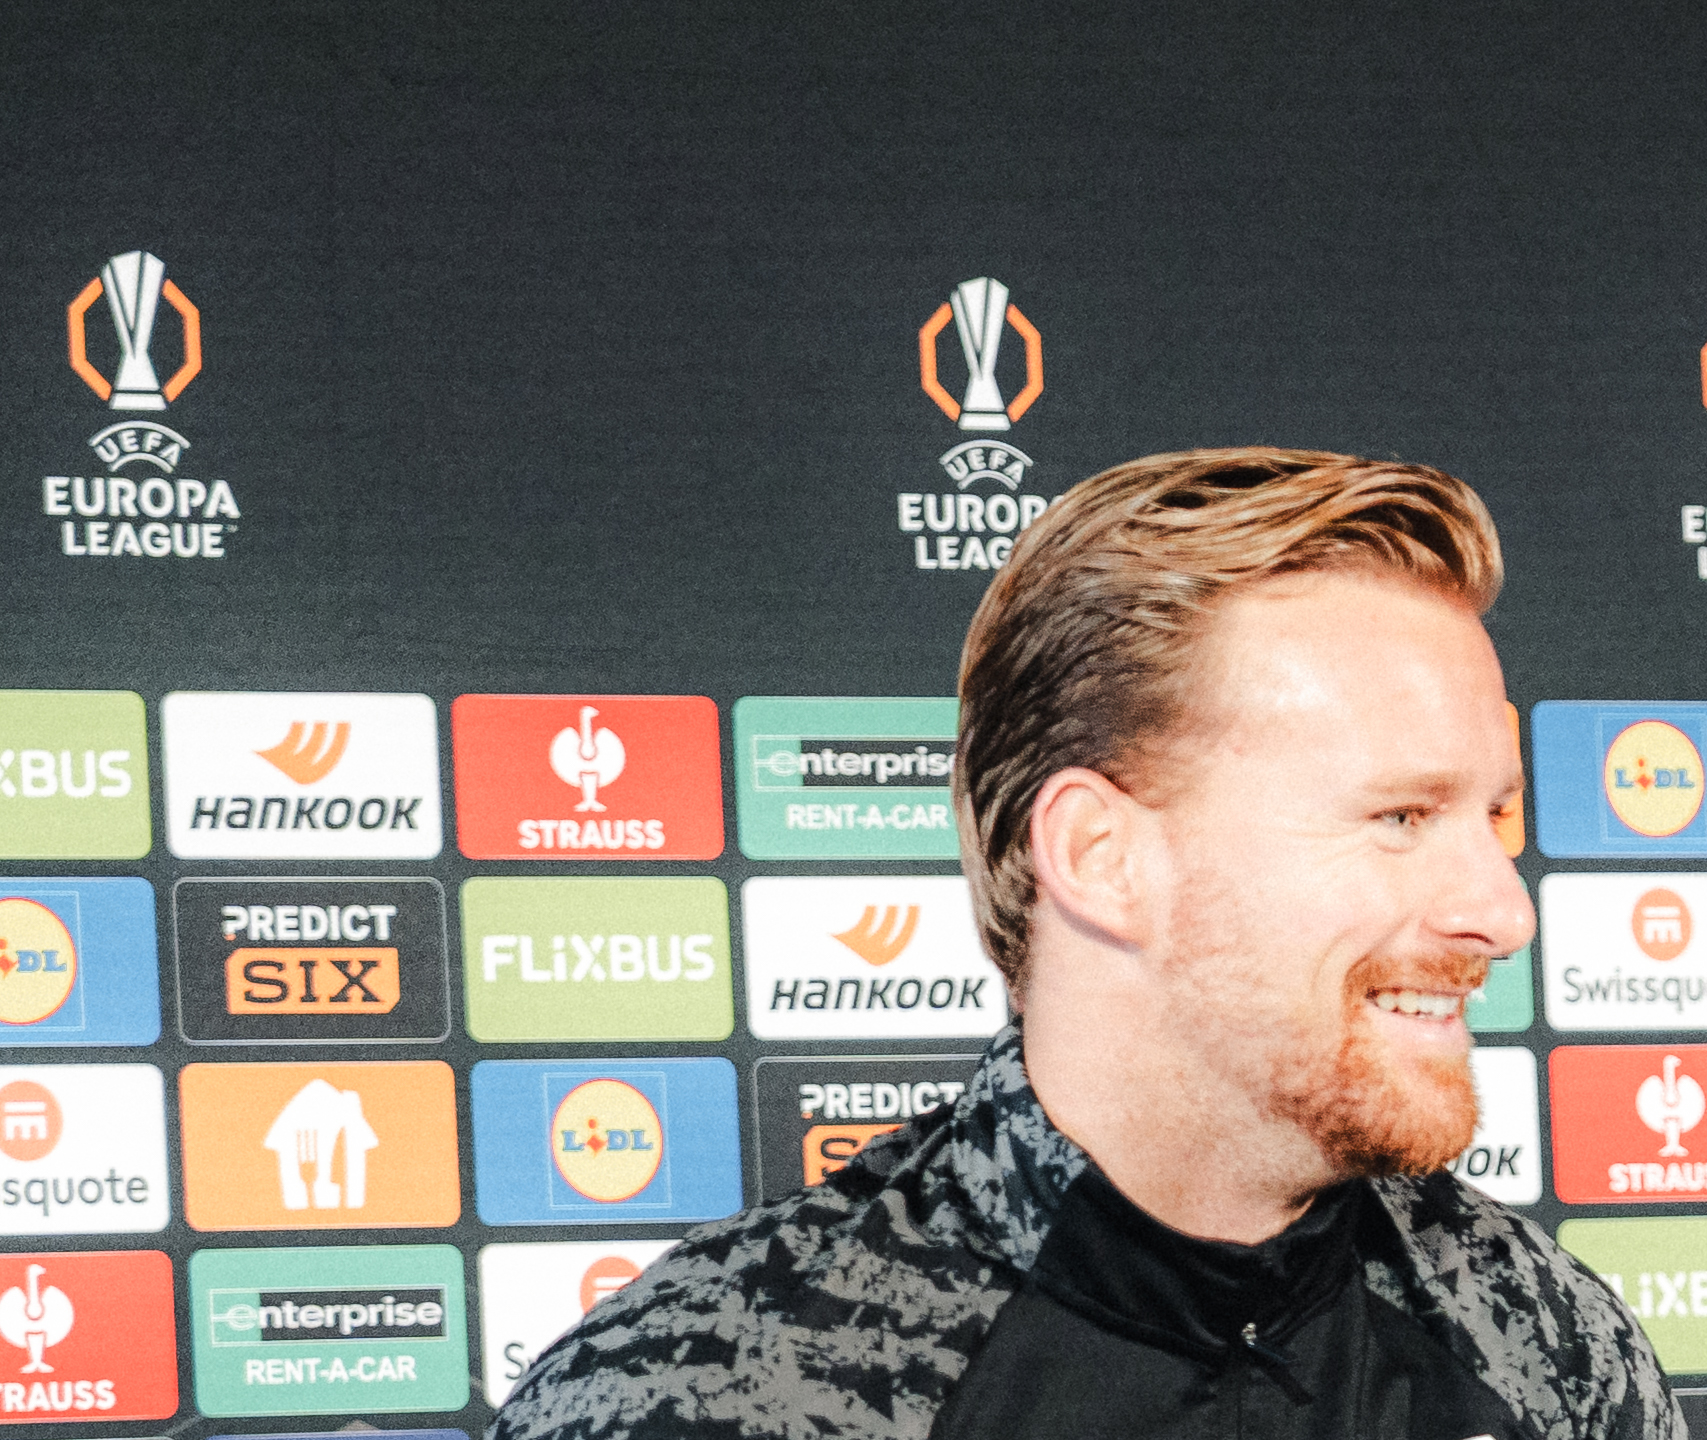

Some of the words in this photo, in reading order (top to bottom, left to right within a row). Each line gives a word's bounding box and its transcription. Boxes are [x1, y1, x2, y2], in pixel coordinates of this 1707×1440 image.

[95, 429, 182, 464] UEFA
[945, 447, 1025, 482] UEFA
[43, 476, 240, 518] EUROPA
[897, 493, 1058, 532] EUROP
[62, 521, 225, 558] LEAGUE
[518, 819, 666, 850] STRAUSS
[786, 804, 949, 831] RENT-A-CAR
[222, 905, 398, 941] PREDICT
[243, 960, 382, 1003] SIX
[226, 1295, 443, 1336] enterprise
[245, 1355, 417, 1385] RENT-A-CAR
[0, 1379, 117, 1412] RAUSS
